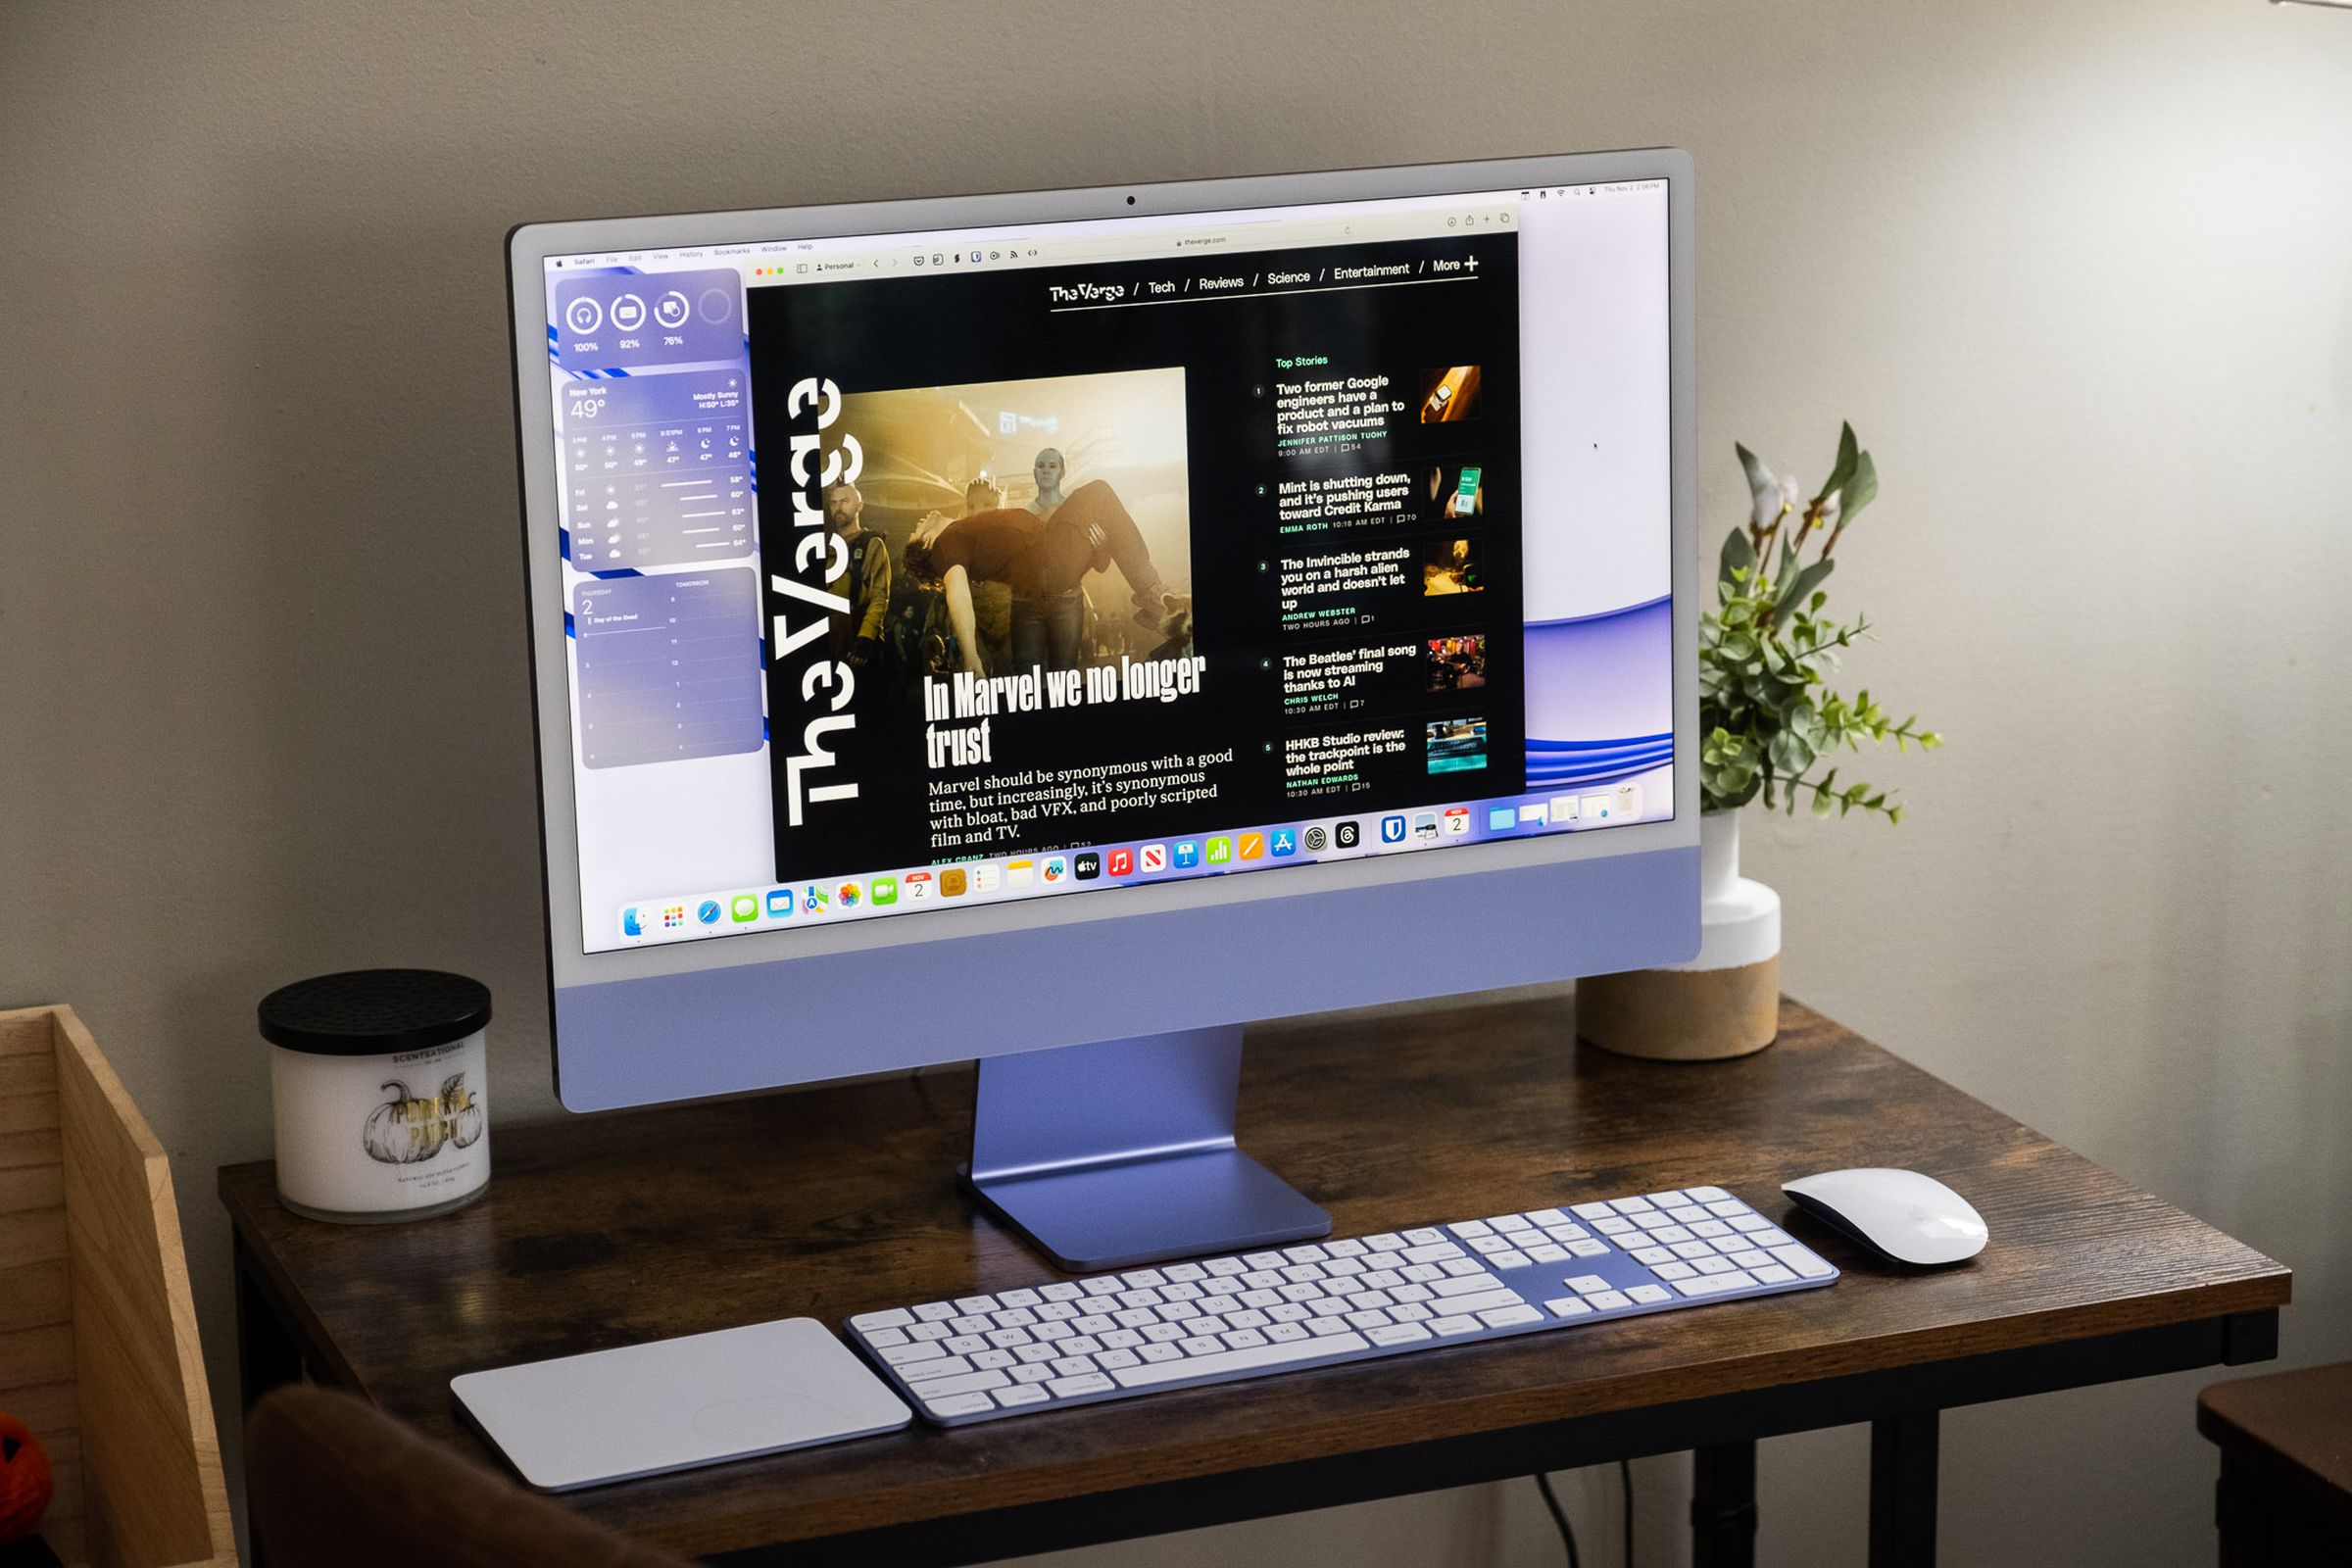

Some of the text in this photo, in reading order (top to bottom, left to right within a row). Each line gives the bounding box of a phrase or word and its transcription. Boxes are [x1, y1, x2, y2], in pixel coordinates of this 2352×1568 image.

[1184, 237, 1226, 246] theverge.com
[573, 257, 595, 266] Safari
[712, 246, 750, 256] Bookmarks
[760, 243, 787, 253] Window
[797, 242, 812, 251] Help
[824, 261, 855, 270] Personal
[1148, 280, 1175, 293] Tech
[1199, 276, 1245, 290] Reviews
[1267, 271, 1310, 284] Science
[1334, 263, 1410, 279] Entertainment
[1433, 259, 1460, 271] More
[573, 342, 599, 353] 100%
[619, 339, 640, 350] 92%
[663, 335, 684, 346] 76%
[1275, 355, 1328, 368] Top Stories
[568, 386, 608, 397] New York
[1275, 374, 1389, 395] Two former Google
[692, 390, 739, 402] Mostly Sunny
[1276, 390, 1377, 410] engineers have a
[1276, 400, 1404, 423] product and a plan to
[1276, 416, 1385, 435] fix robot vacuums
[1277, 429, 1387, 447] JENNIFER PATTISON TUOHY
[1277, 445, 1329, 458] 9:00 AM EDT
[1278, 472, 1410, 494] Mint is shutting down,
[1279, 486, 1409, 508] and it's pushing users
[1279, 500, 1401, 520] toward Credit Karma
[1279, 524, 1303, 534] EMMA
[1305, 521, 1328, 530] ROTH
[1354, 517, 1368, 526] AM
[1369, 515, 1385, 525] EDT
[1280, 547, 1410, 570] The Invincible strands
[1280, 562, 1398, 585] you on a harsh alien
[1280, 573, 1405, 597] world and doesn't let
[581, 599, 594, 615] 2
[1281, 599, 1298, 611] up
[1281, 607, 1355, 621] ANDREW WEBSTER
[1302, 619, 1330, 628] HOURS
[1282, 645, 1416, 670] The Beatles' final song
[1283, 661, 1383, 680] is now streaming
[924, 655, 1205, 721] In Marvel we no longer
[1283, 674, 1355, 693] thanks to AI
[1283, 692, 1339, 705] CHRIS WELCH
[1284, 706, 1306, 714] 10:30
[1323, 702, 1339, 710] EDT
[925, 716, 991, 768] trust
[1285, 728, 1404, 751] HHKB Studio review:
[1285, 740, 1406, 763] the trackpoint is the
[928, 747, 1233, 796] Marvel should be synonymous with a good
[1285, 759, 1354, 776] whole point
[1286, 773, 1358, 788] NATHAN EDWARDS
[928, 771, 1205, 813] time, but increasingly, it's synonymous
[1286, 789, 1308, 798] 10:30
[1325, 785, 1341, 794] EDT
[929, 783, 1217, 830] with bloat, bad VFX, and poorly scripted
[1452, 817, 1462, 831] 2
[930, 824, 1020, 848] film and TV.
[914, 883, 924, 898] 2
